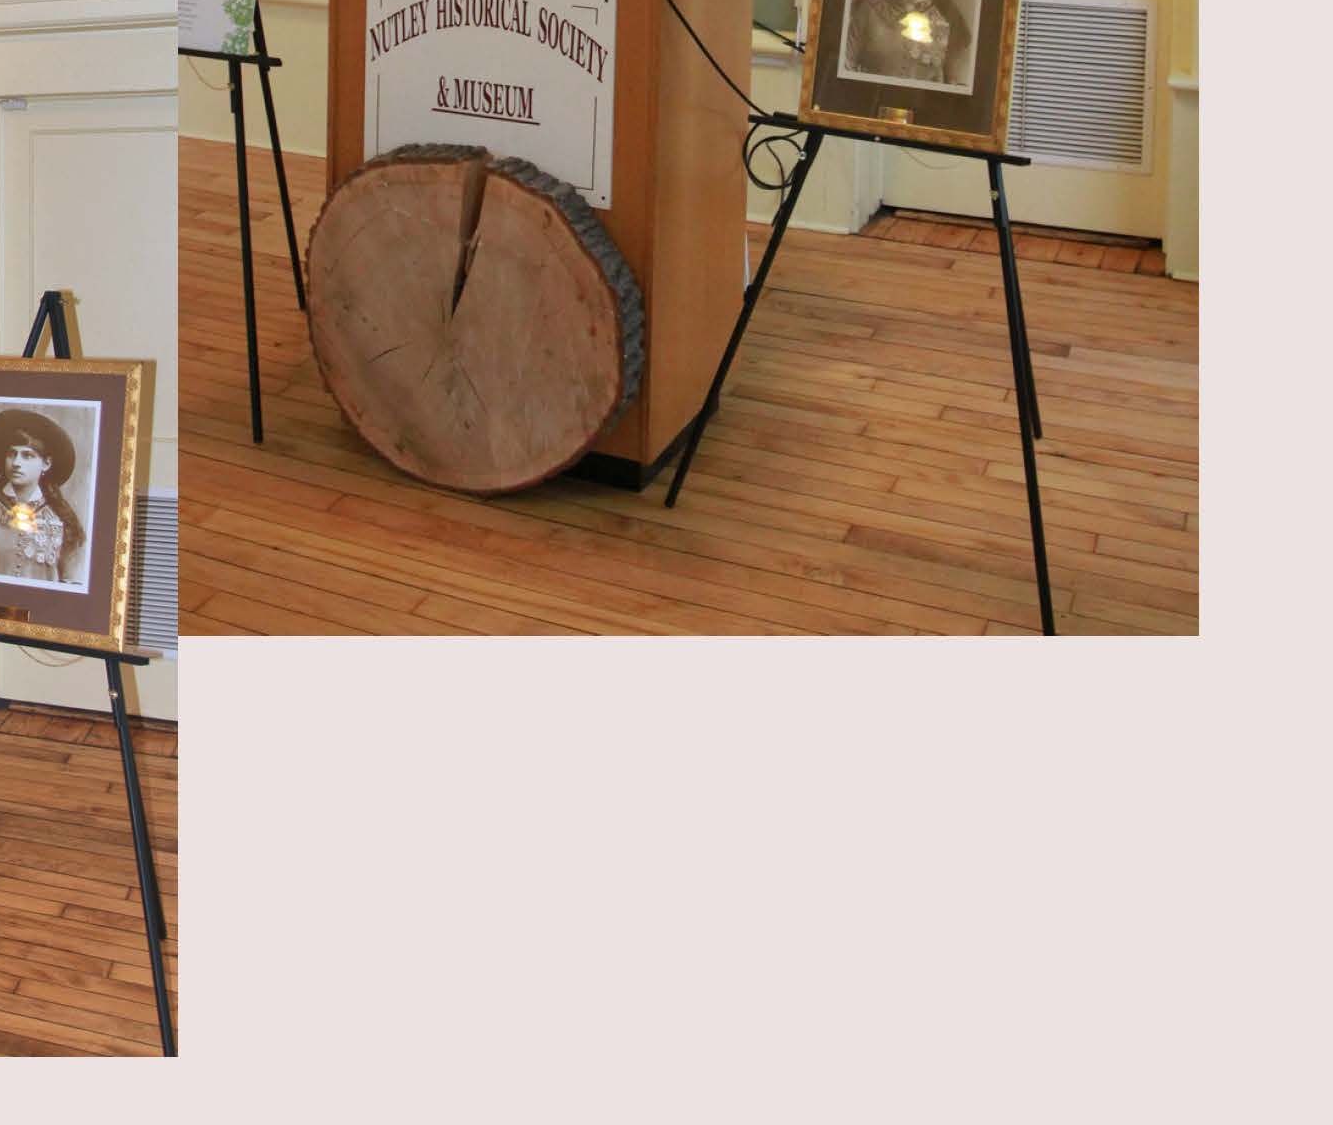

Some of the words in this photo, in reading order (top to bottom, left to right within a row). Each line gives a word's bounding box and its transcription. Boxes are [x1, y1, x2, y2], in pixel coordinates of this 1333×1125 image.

[538, 6, 608, 83] SOCIETY
[437, 75, 450, 108] &
[453, 78, 534, 119] MUSEUM
